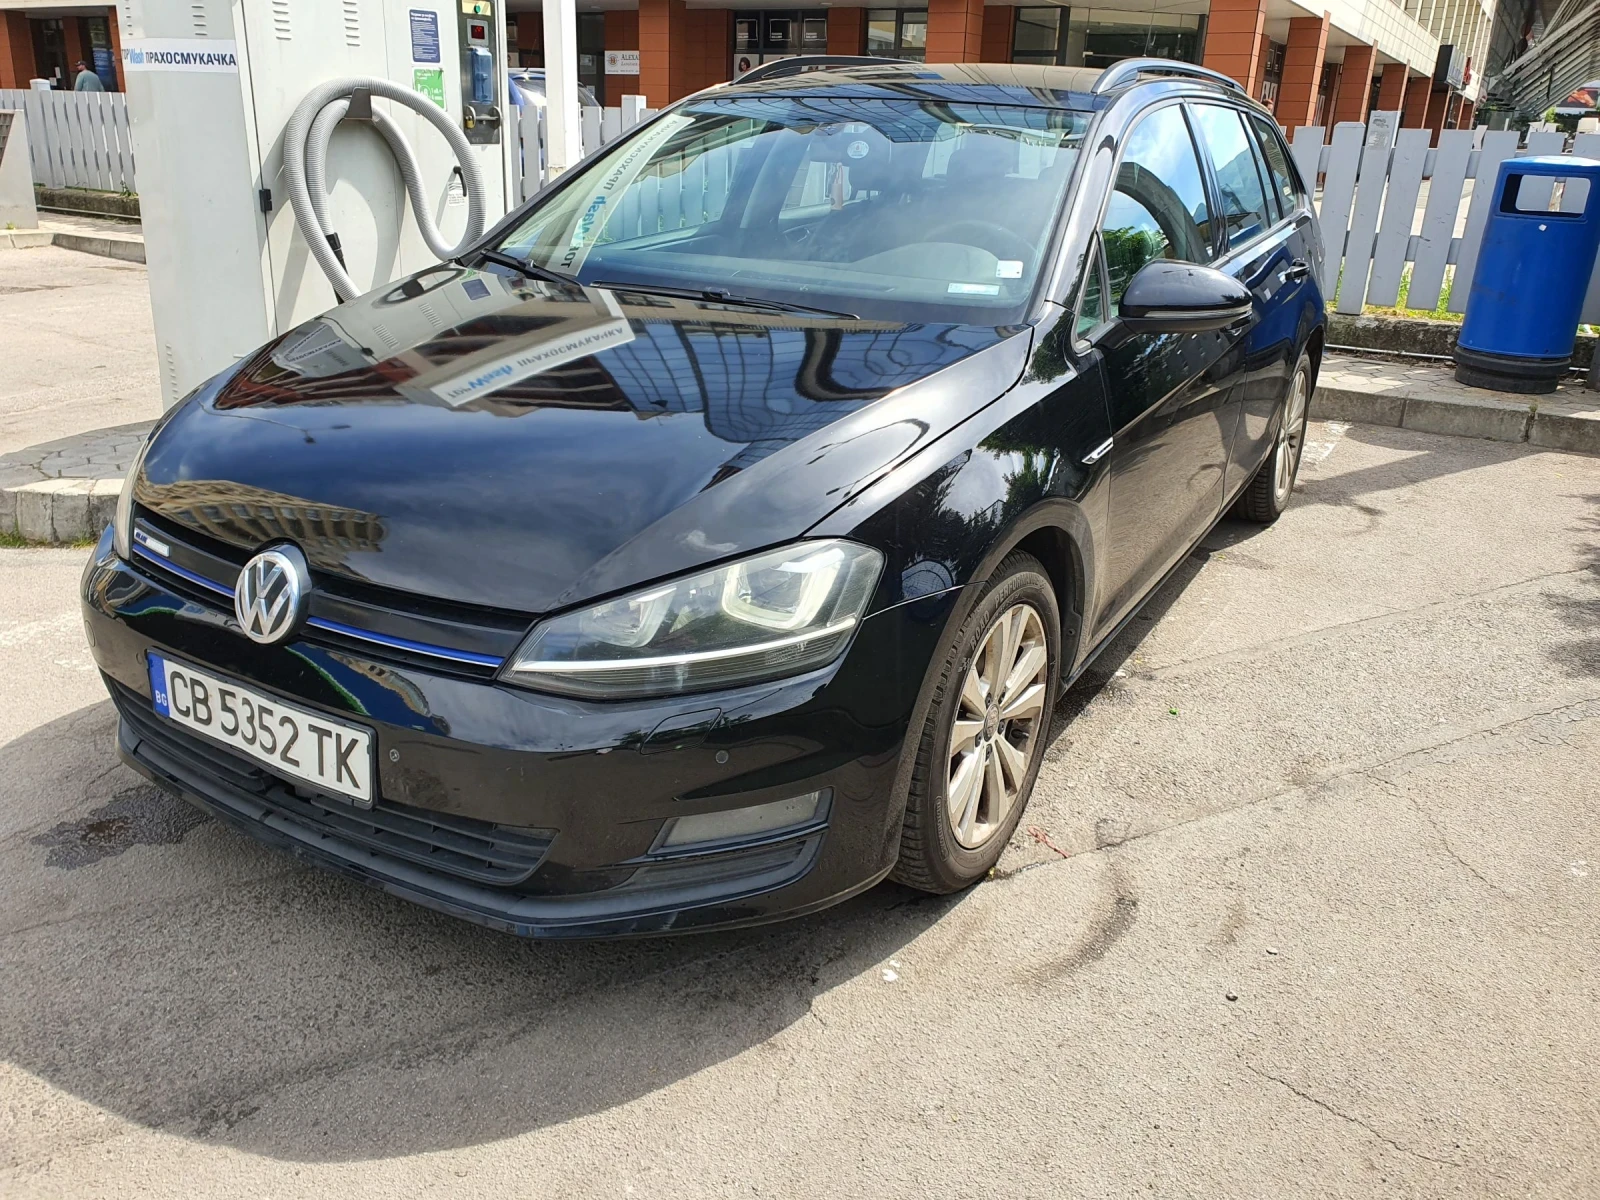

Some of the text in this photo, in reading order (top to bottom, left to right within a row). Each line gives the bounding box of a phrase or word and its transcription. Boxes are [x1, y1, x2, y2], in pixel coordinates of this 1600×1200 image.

[145, 52, 237, 66] ПРАХОСМУКАЧКА
[155, 689, 168, 707] BG
[218, 687, 301, 768] 5352
[308, 723, 361, 790] TK
